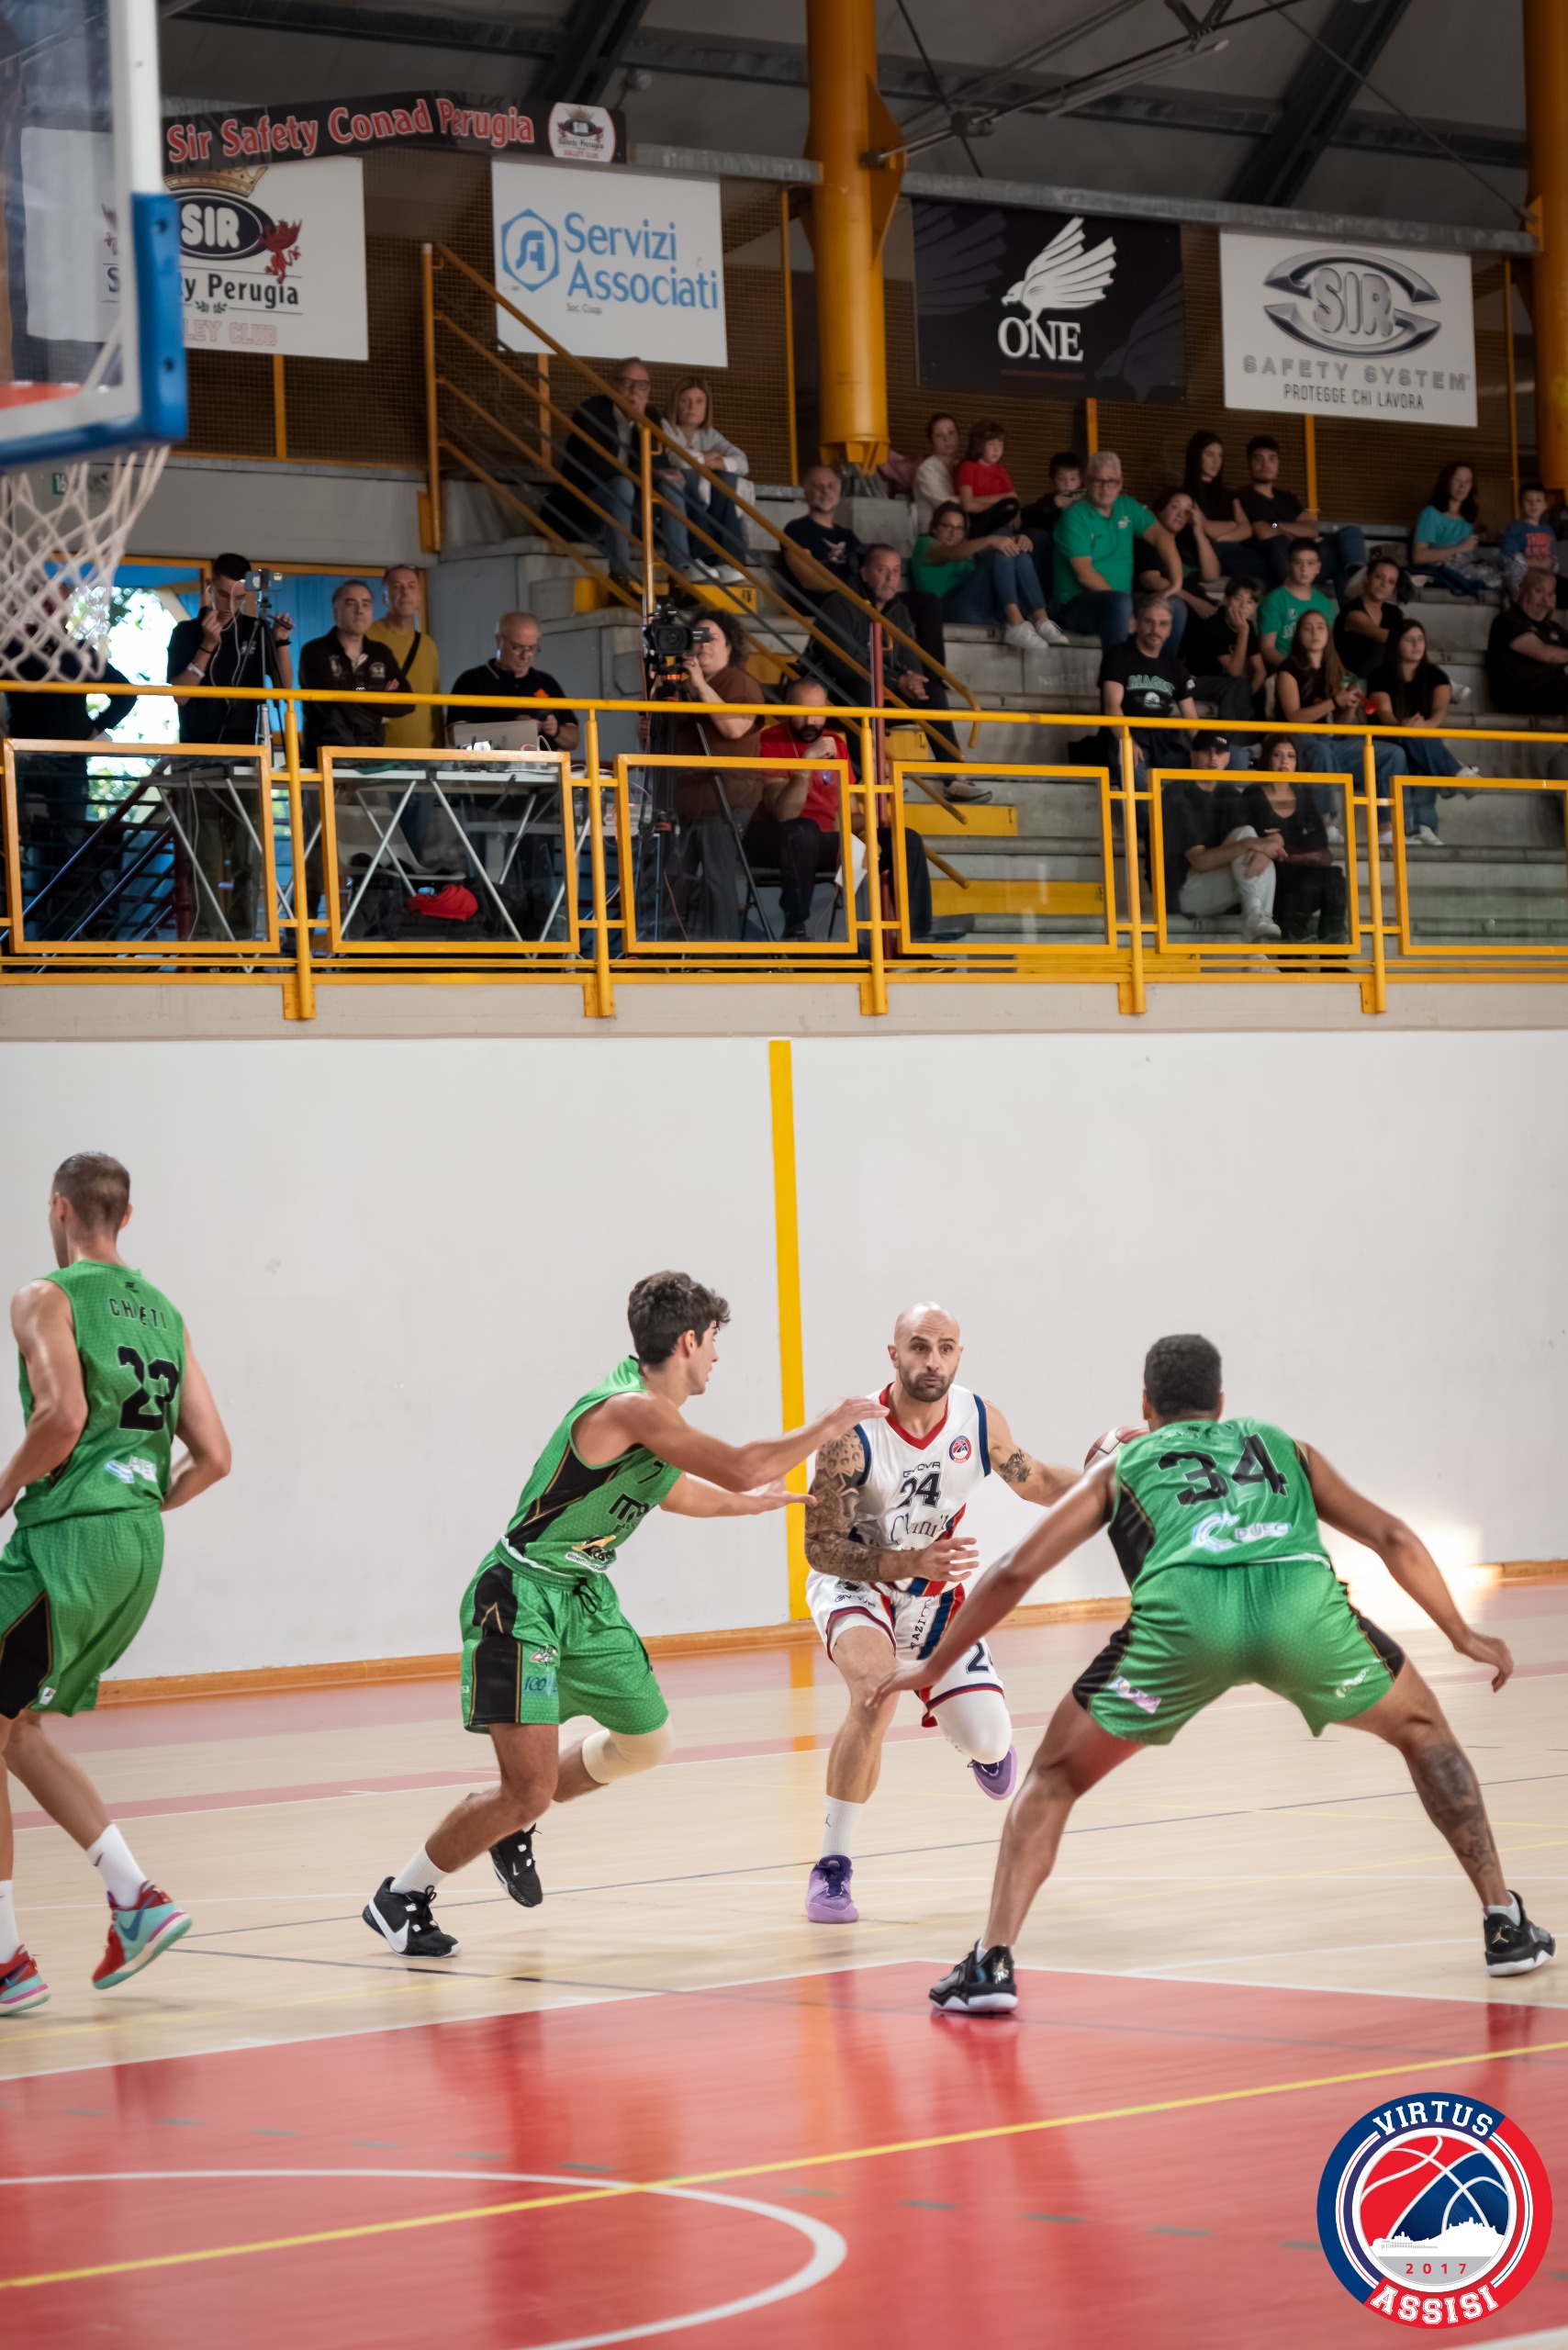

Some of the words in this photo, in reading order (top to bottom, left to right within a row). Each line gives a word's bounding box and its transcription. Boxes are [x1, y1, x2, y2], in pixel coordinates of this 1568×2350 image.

[167, 124, 212, 162] Sir
[220, 114, 319, 156] Safety
[328, 98, 434, 144] Conad
[435, 98, 534, 149] Perugia
[181, 203, 240, 249] SIR
[564, 211, 677, 261] Servizi
[207, 274, 299, 309] Perugia
[566, 258, 719, 308] Associati
[1313, 267, 1394, 338] SIR
[184, 319, 222, 342] LEY
[997, 317, 1084, 363] ONE
[1243, 354, 1349, 381] SAFETY
[1364, 364, 1468, 392] SYSTEM
[1284, 383, 1347, 404] PROTEGGE
[1351, 388, 1372, 407] CHI
[1378, 391, 1425, 410] LAVORA
[897, 1472, 942, 1508] 24
[1158, 1432, 1288, 1505] 34
[965, 1640, 994, 1674] 2
